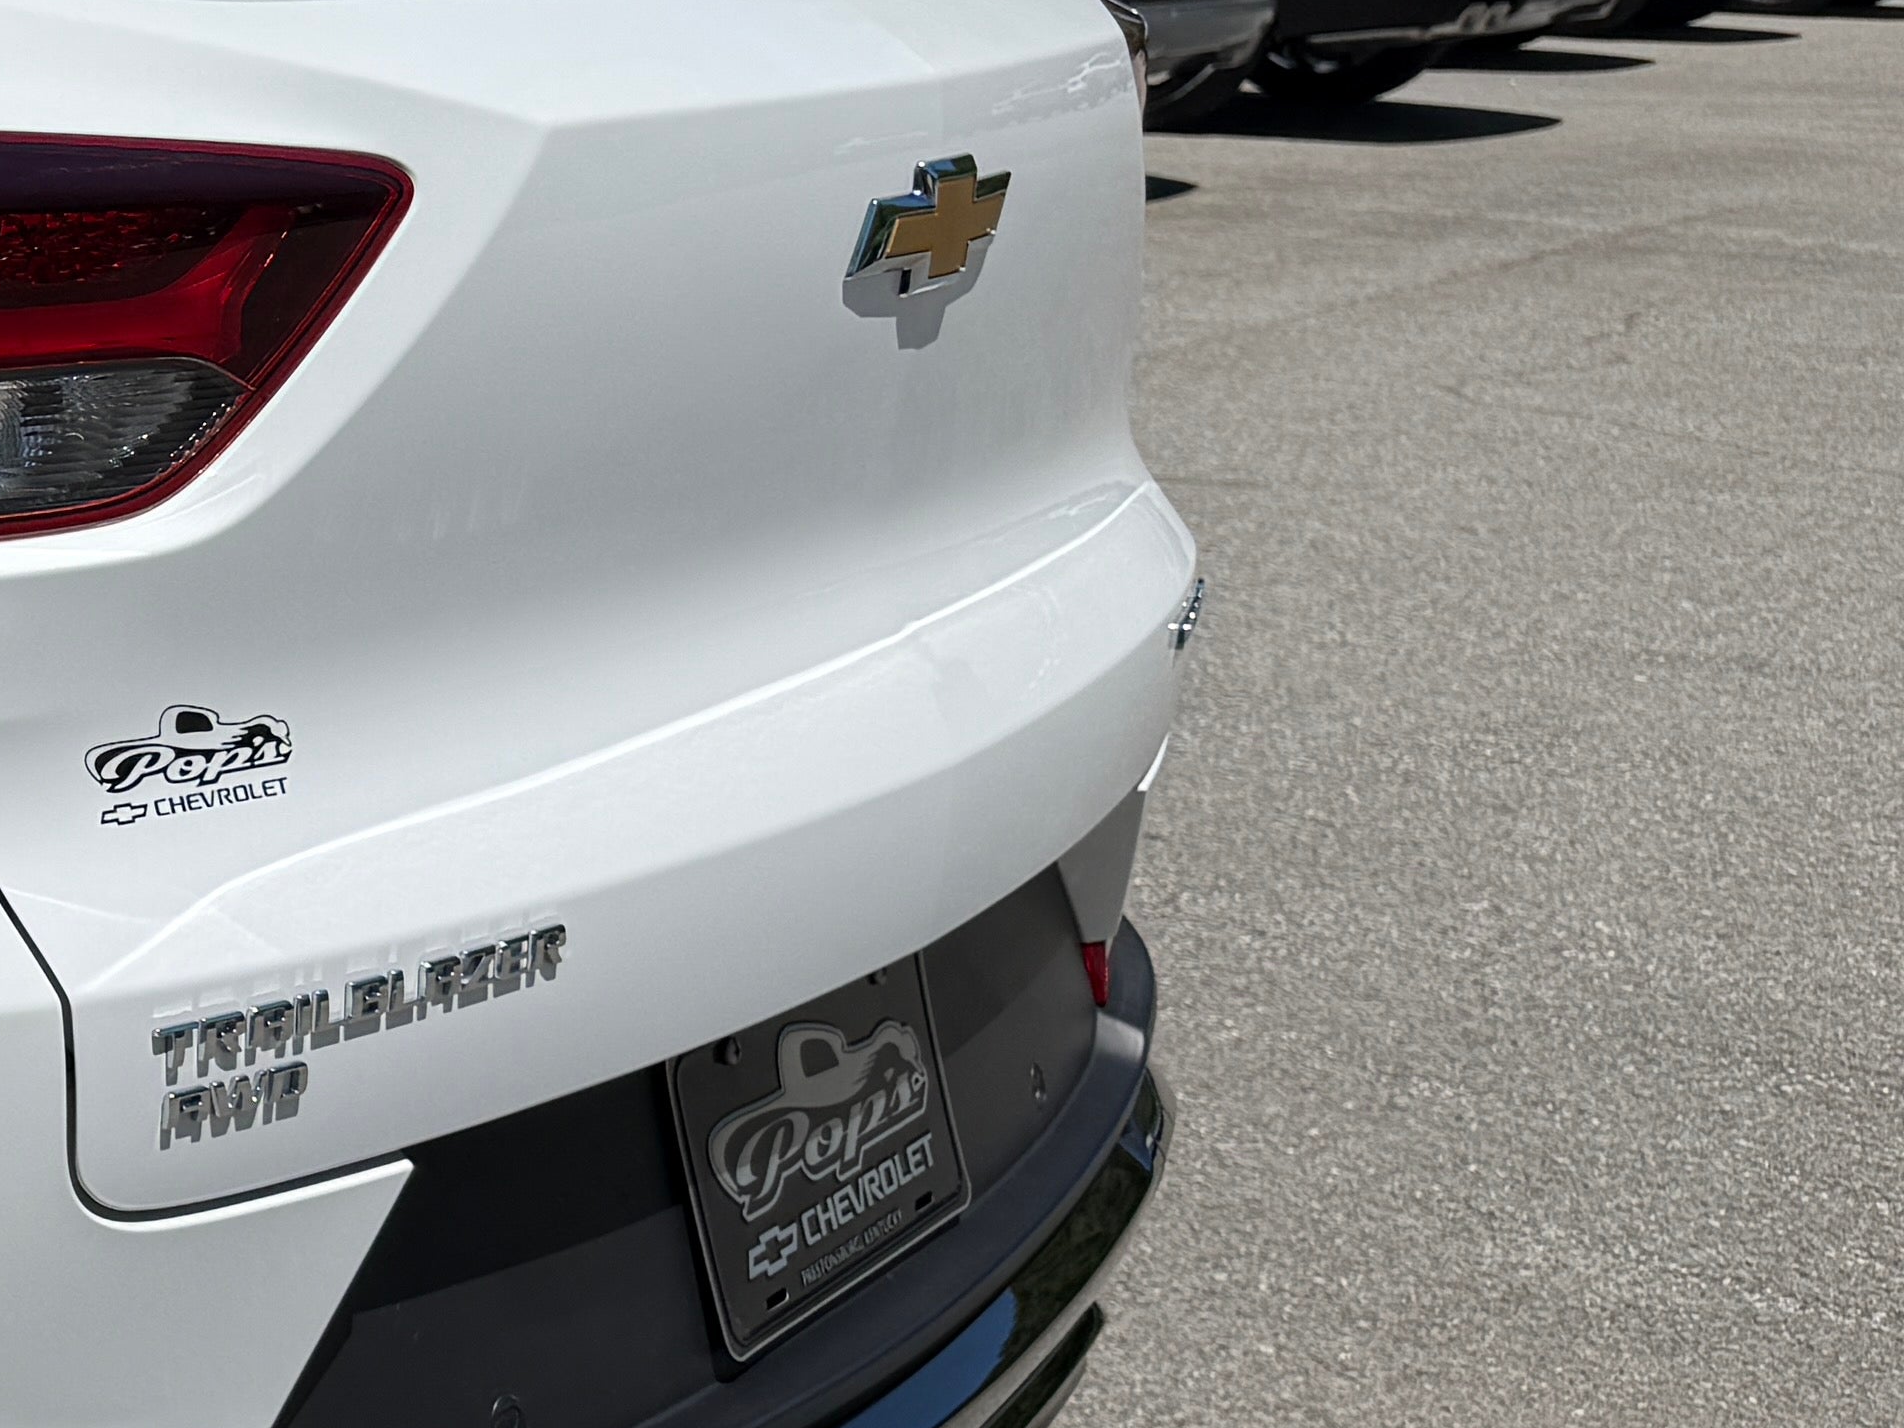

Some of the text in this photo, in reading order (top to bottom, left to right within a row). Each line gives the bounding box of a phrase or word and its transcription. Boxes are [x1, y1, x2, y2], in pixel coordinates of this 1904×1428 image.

[96, 736, 293, 793] Pop's
[153, 776, 288, 817] CHEVROLET
[151, 923, 566, 1077] TRAILBLAZER
[159, 1060, 309, 1138] AWD
[735, 1068, 927, 1200] Pop's
[800, 1133, 934, 1247] CHEVROLET
